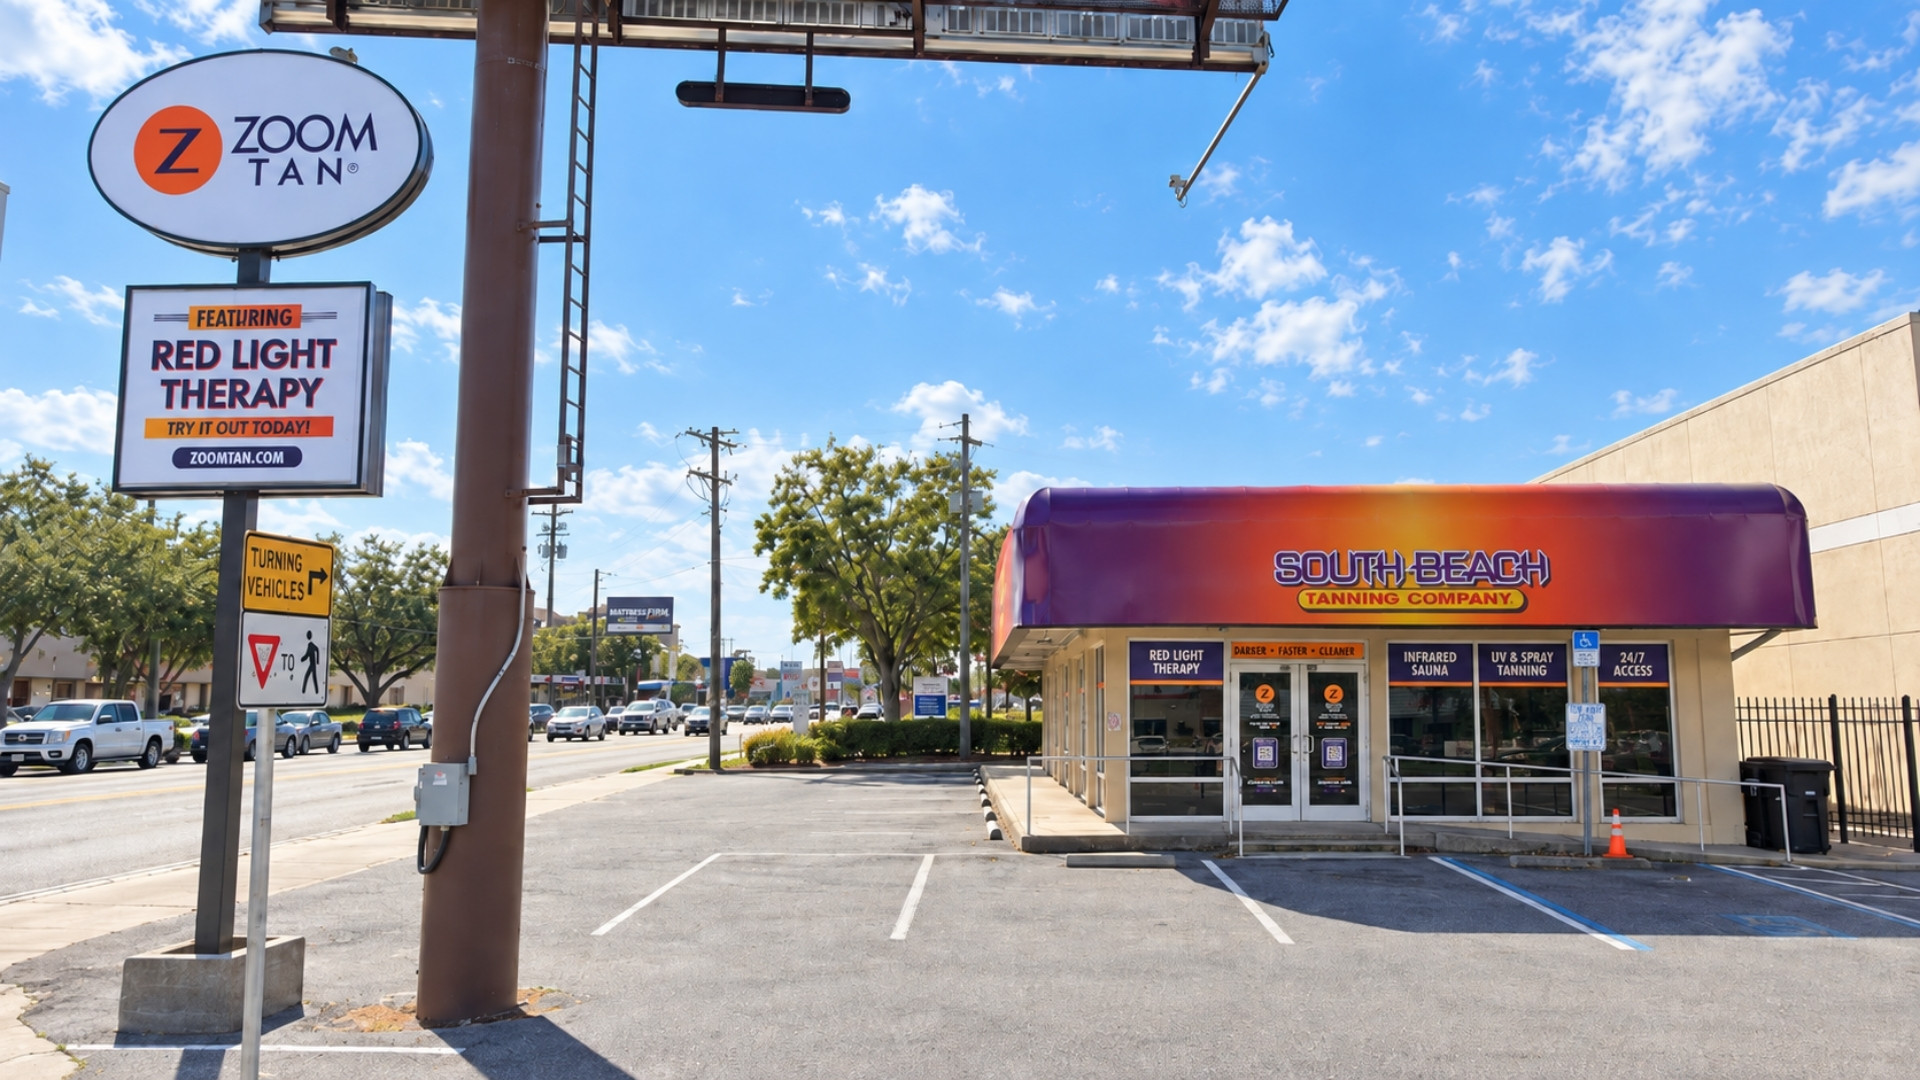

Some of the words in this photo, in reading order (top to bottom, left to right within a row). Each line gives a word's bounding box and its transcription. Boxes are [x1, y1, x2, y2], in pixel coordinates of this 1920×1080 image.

[231, 112, 378, 154] ZOOM
[154, 128, 202, 174] Z
[151, 339, 222, 371] RED
[232, 338, 338, 370] LIGHT
[160, 377, 325, 410] THERAPY
[167, 421, 196, 436] TRY
[199, 421, 212, 436] IT
[216, 420, 250, 435] OUT
[252, 420, 311, 434] TODAY!
[190, 451, 285, 465] ZOOMTAN.COM
[251, 546, 303, 573] TURNING
[1273, 549, 1405, 588] SOUTH
[1405, 549, 1552, 588] BEACH
[247, 576, 305, 601] VEHICLES
[1306, 592, 1400, 605] TANNING
[1150, 650, 1170, 661] RED
[1173, 650, 1204, 661] LIGHT
[1278, 646, 1308, 656] FASTER
[1319, 646, 1355, 656] CLEANER
[1403, 651, 1457, 663] INFRARED
[1491, 651, 1507, 663] UV
[1509, 651, 1519, 663] &
[1521, 651, 1554, 664] SPRAY
[281, 653, 295, 671] TO
[1620, 652, 1645, 664] 24/7
[1153, 662, 1201, 675] THERAPY
[1411, 664, 1449, 676] SAUNA
[1497, 664, 1548, 676] TANNING
[1613, 664, 1653, 677] ACCESS
